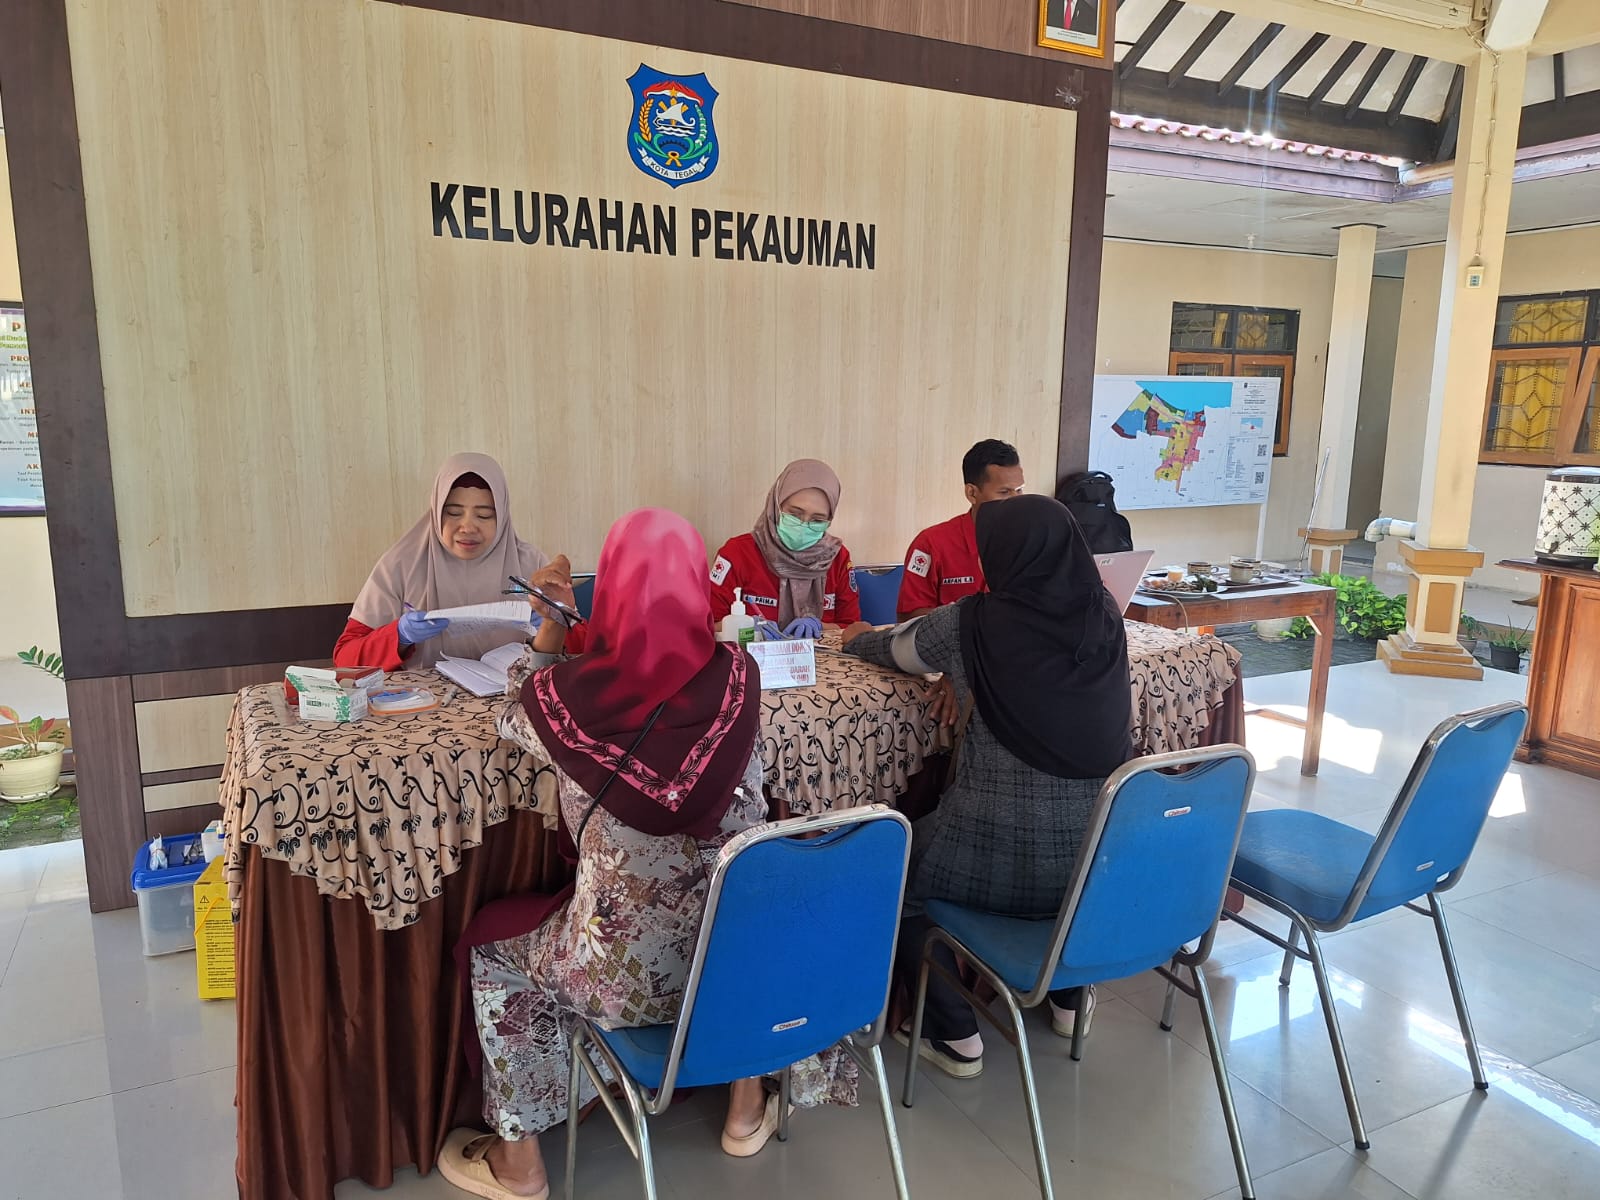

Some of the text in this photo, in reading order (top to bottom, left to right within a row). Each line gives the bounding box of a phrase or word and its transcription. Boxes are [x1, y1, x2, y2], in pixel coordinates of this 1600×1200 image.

[650, 162, 697, 178] KOTA TEGAL
[430, 181, 876, 270] KELURAHAN PEKAUMAN
[911, 564, 923, 573] PMI
[754, 597, 772, 605] PRIMA
